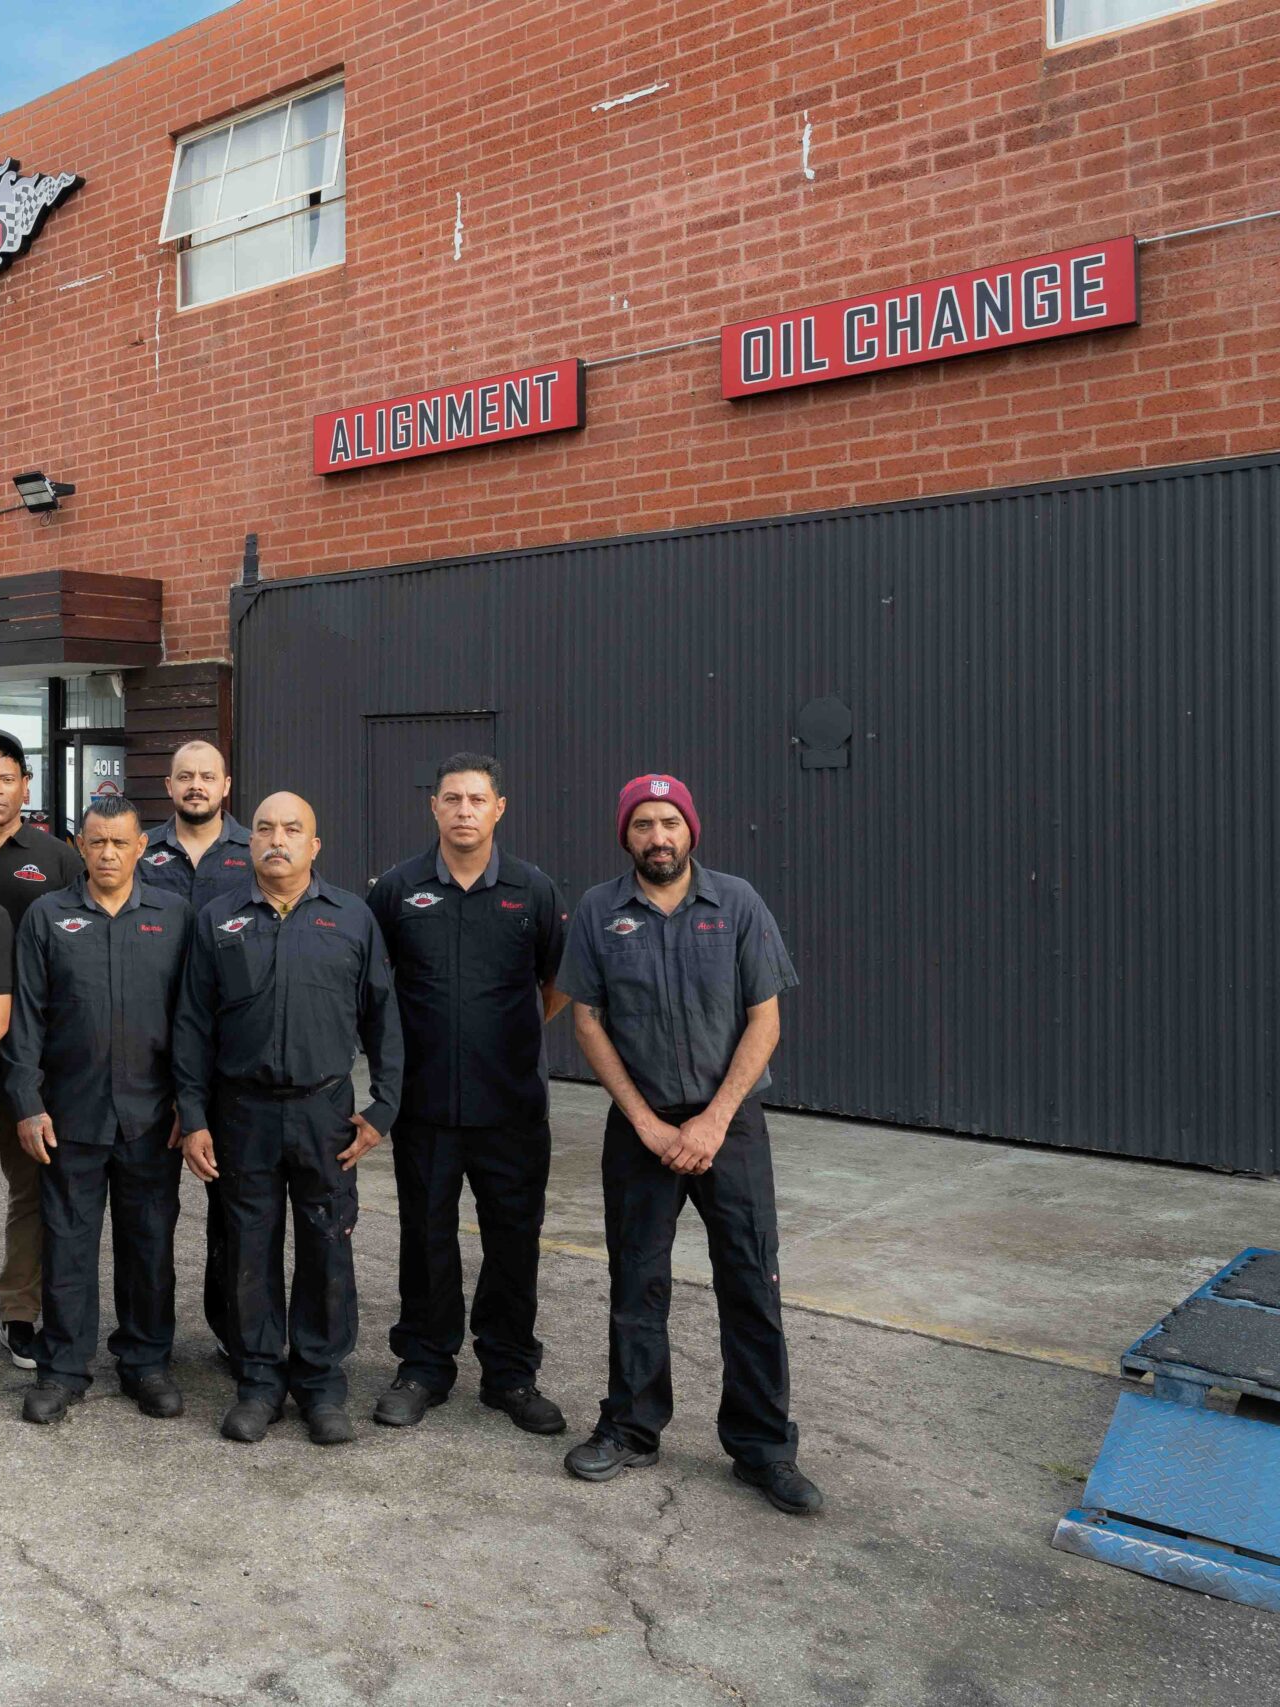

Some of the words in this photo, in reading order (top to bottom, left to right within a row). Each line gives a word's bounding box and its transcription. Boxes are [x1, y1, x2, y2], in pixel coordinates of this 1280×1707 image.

[740, 316, 829, 385] OIL
[843, 252, 1108, 365] CHANGE
[328, 370, 559, 464] ALIGNMENT
[93, 758, 111, 776] 401
[113, 760, 120, 776] E
